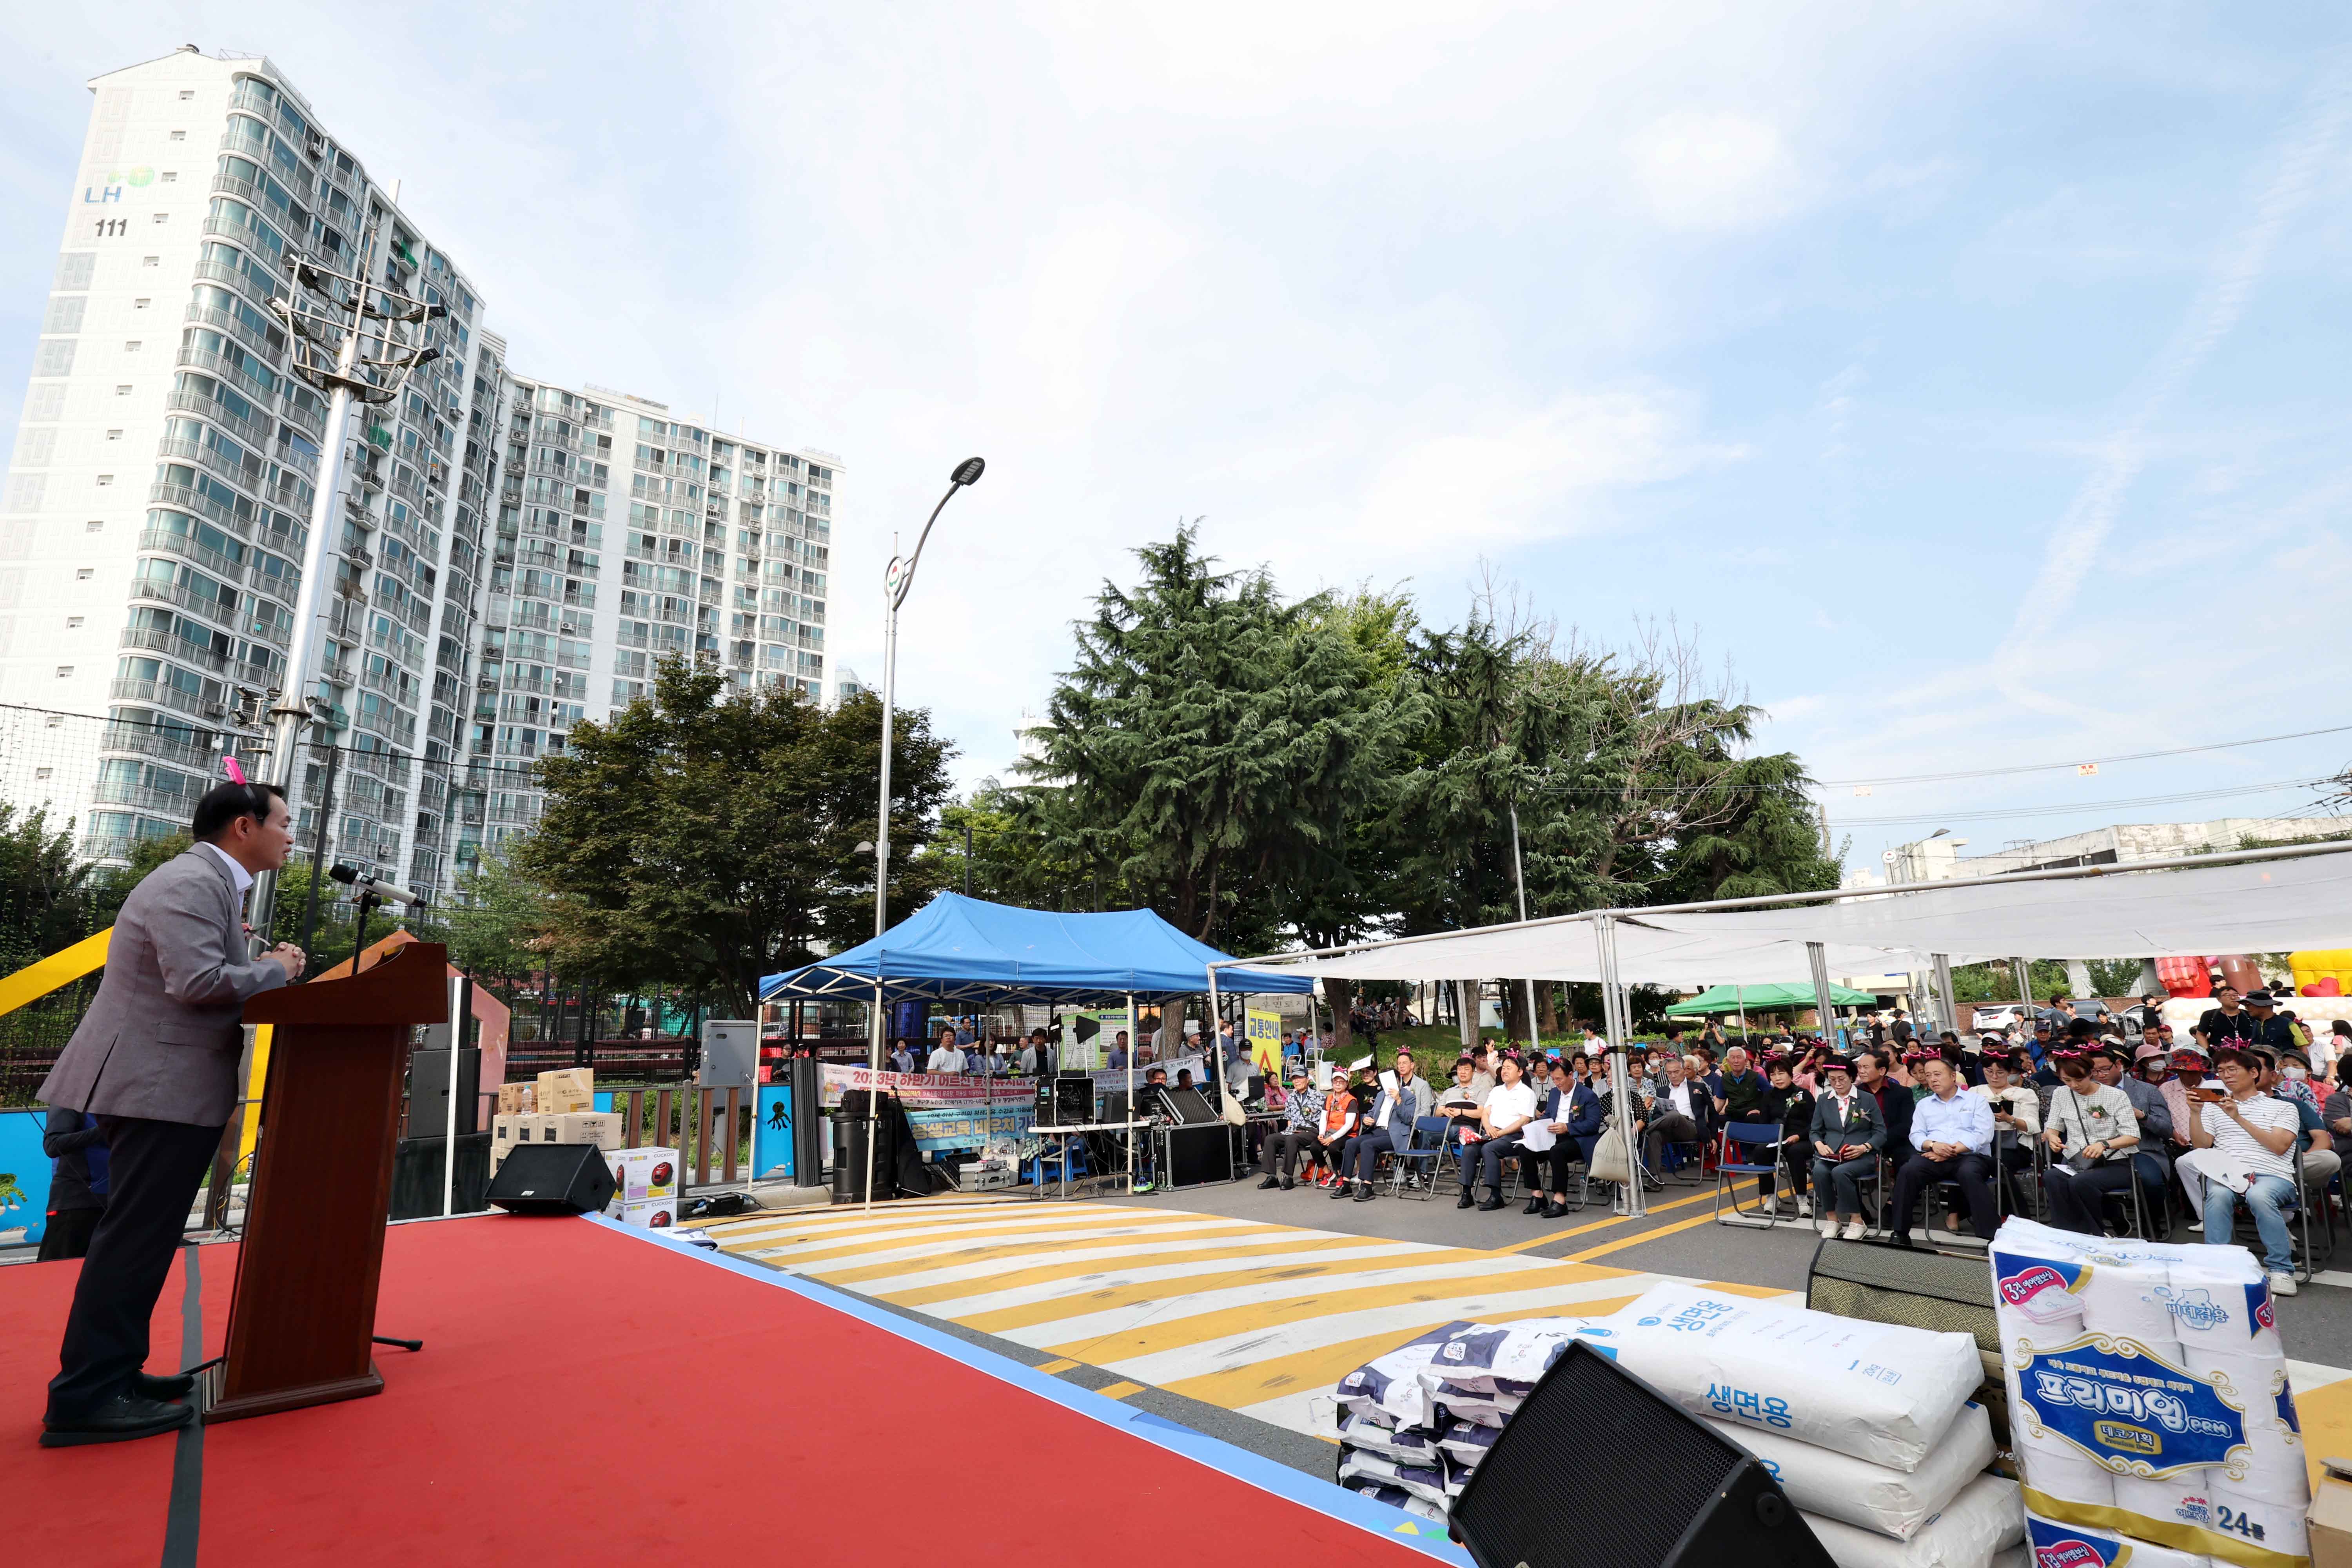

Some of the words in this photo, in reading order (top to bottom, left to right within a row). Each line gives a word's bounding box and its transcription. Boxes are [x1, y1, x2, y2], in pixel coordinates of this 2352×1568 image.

[84, 186, 122, 203] LH
[95, 219, 127, 236] 111
[1250, 1018, 1279, 1040] 교통안내
[900, 1073, 935, 1086] 하반기
[938, 1076, 970, 1087] 어르신
[911, 1120, 971, 1140] 평생교육
[973, 1116, 1015, 1135] 바우처
[2004, 1281, 2027, 1301] 3겹
[2023, 1270, 2054, 1289] 에어엠보싱
[1667, 1300, 1734, 1332] 생면용
[2165, 1303, 2229, 1323] 비데겸용
[2047, 1359, 2064, 1370] 더욱
[2098, 1368, 2131, 1383] 부드러운
[2167, 1381, 2194, 1393] 화장지
[1706, 1383, 1793, 1428] 생면용
[2036, 1372, 2187, 1432] 프리미엄
[2190, 1418, 2230, 1437] PRM
[2101, 1425, 2154, 1446] 데코기획
[2176, 1508, 2210, 1523] 허브향
